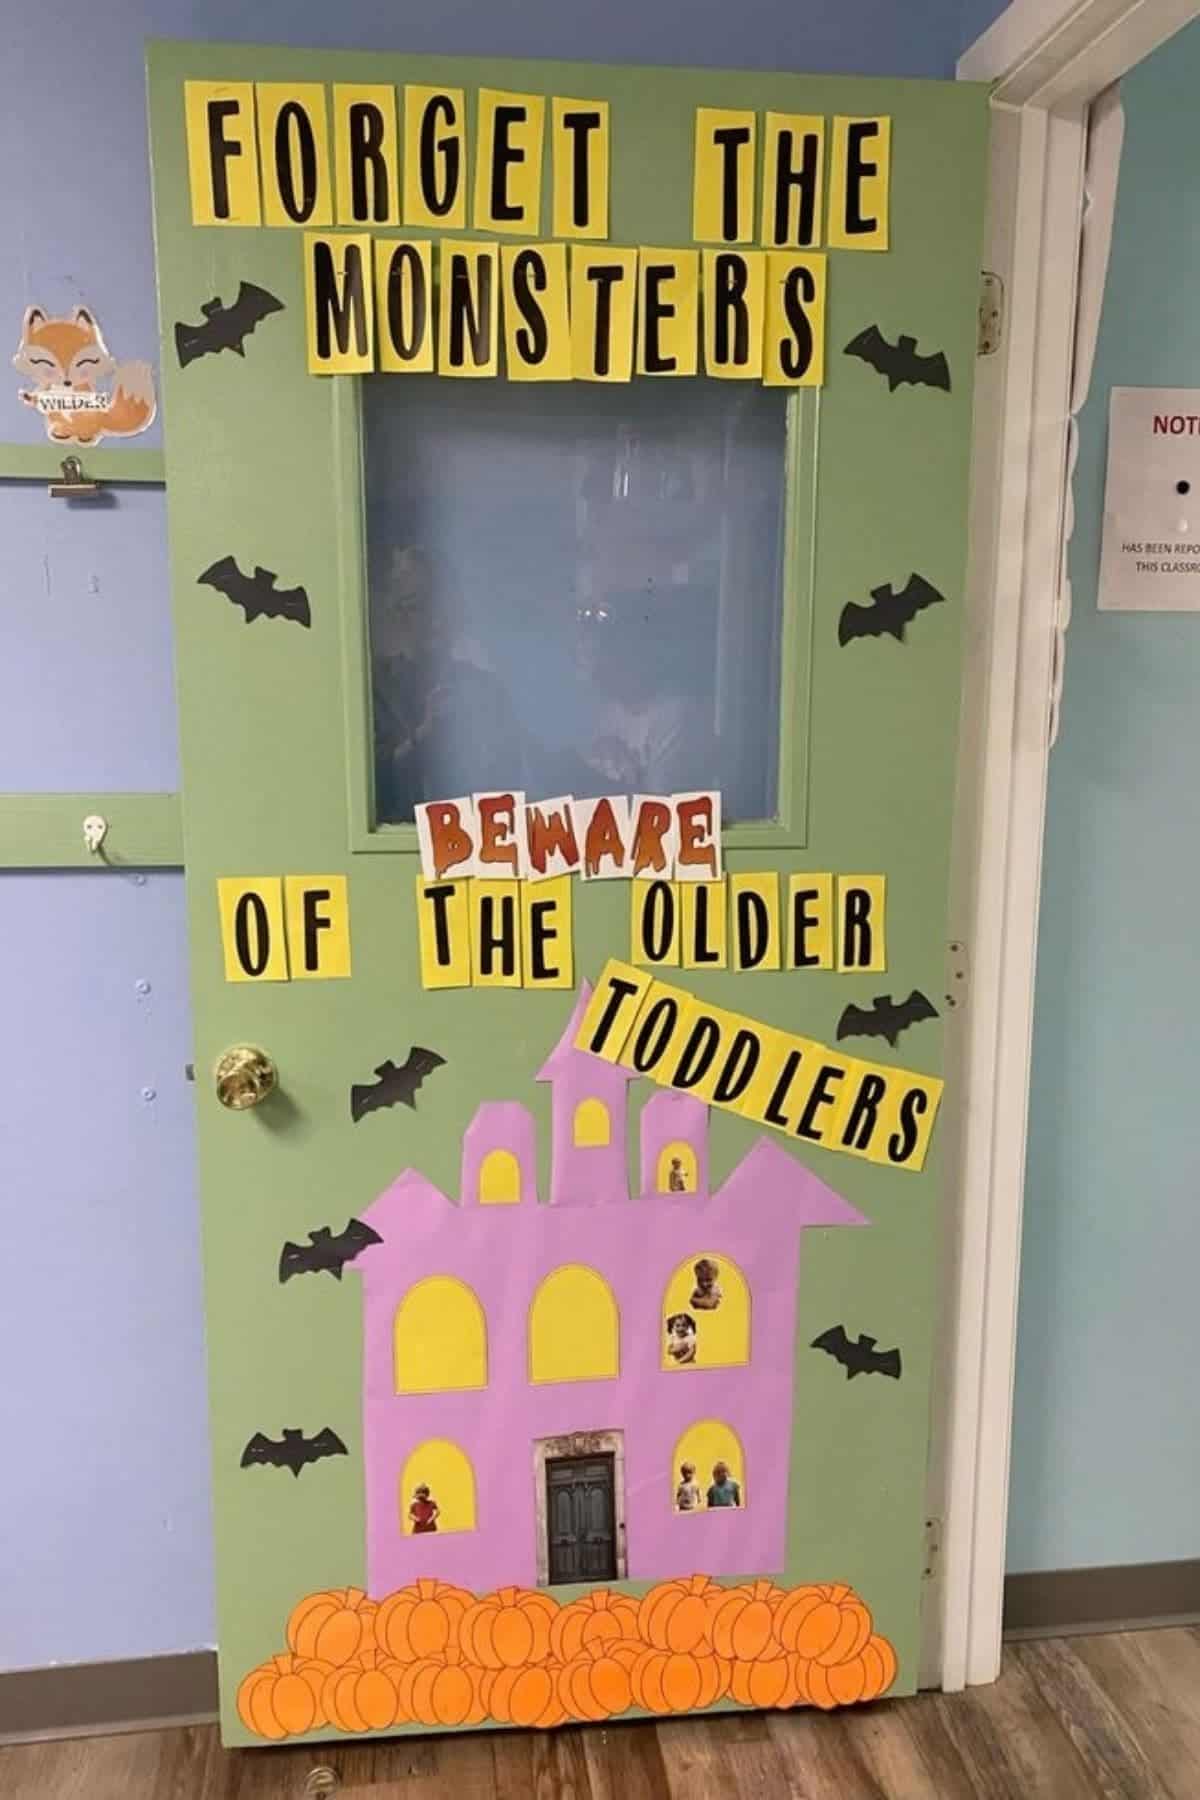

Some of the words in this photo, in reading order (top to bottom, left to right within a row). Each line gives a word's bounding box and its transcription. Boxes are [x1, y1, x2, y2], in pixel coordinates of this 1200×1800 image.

[206, 94, 602, 228] FORGET
[713, 121, 879, 247] THE
[313, 240, 816, 380] MONSTERS
[1121, 543, 1143, 553] HAS
[1136, 561, 1158, 573] THIS
[426, 793, 716, 877] BEWARE
[234, 889, 331, 977] OF
[425, 885, 560, 980] THE
[642, 880, 873, 970] OLDER
[590, 977, 929, 1164] TODDLERS
